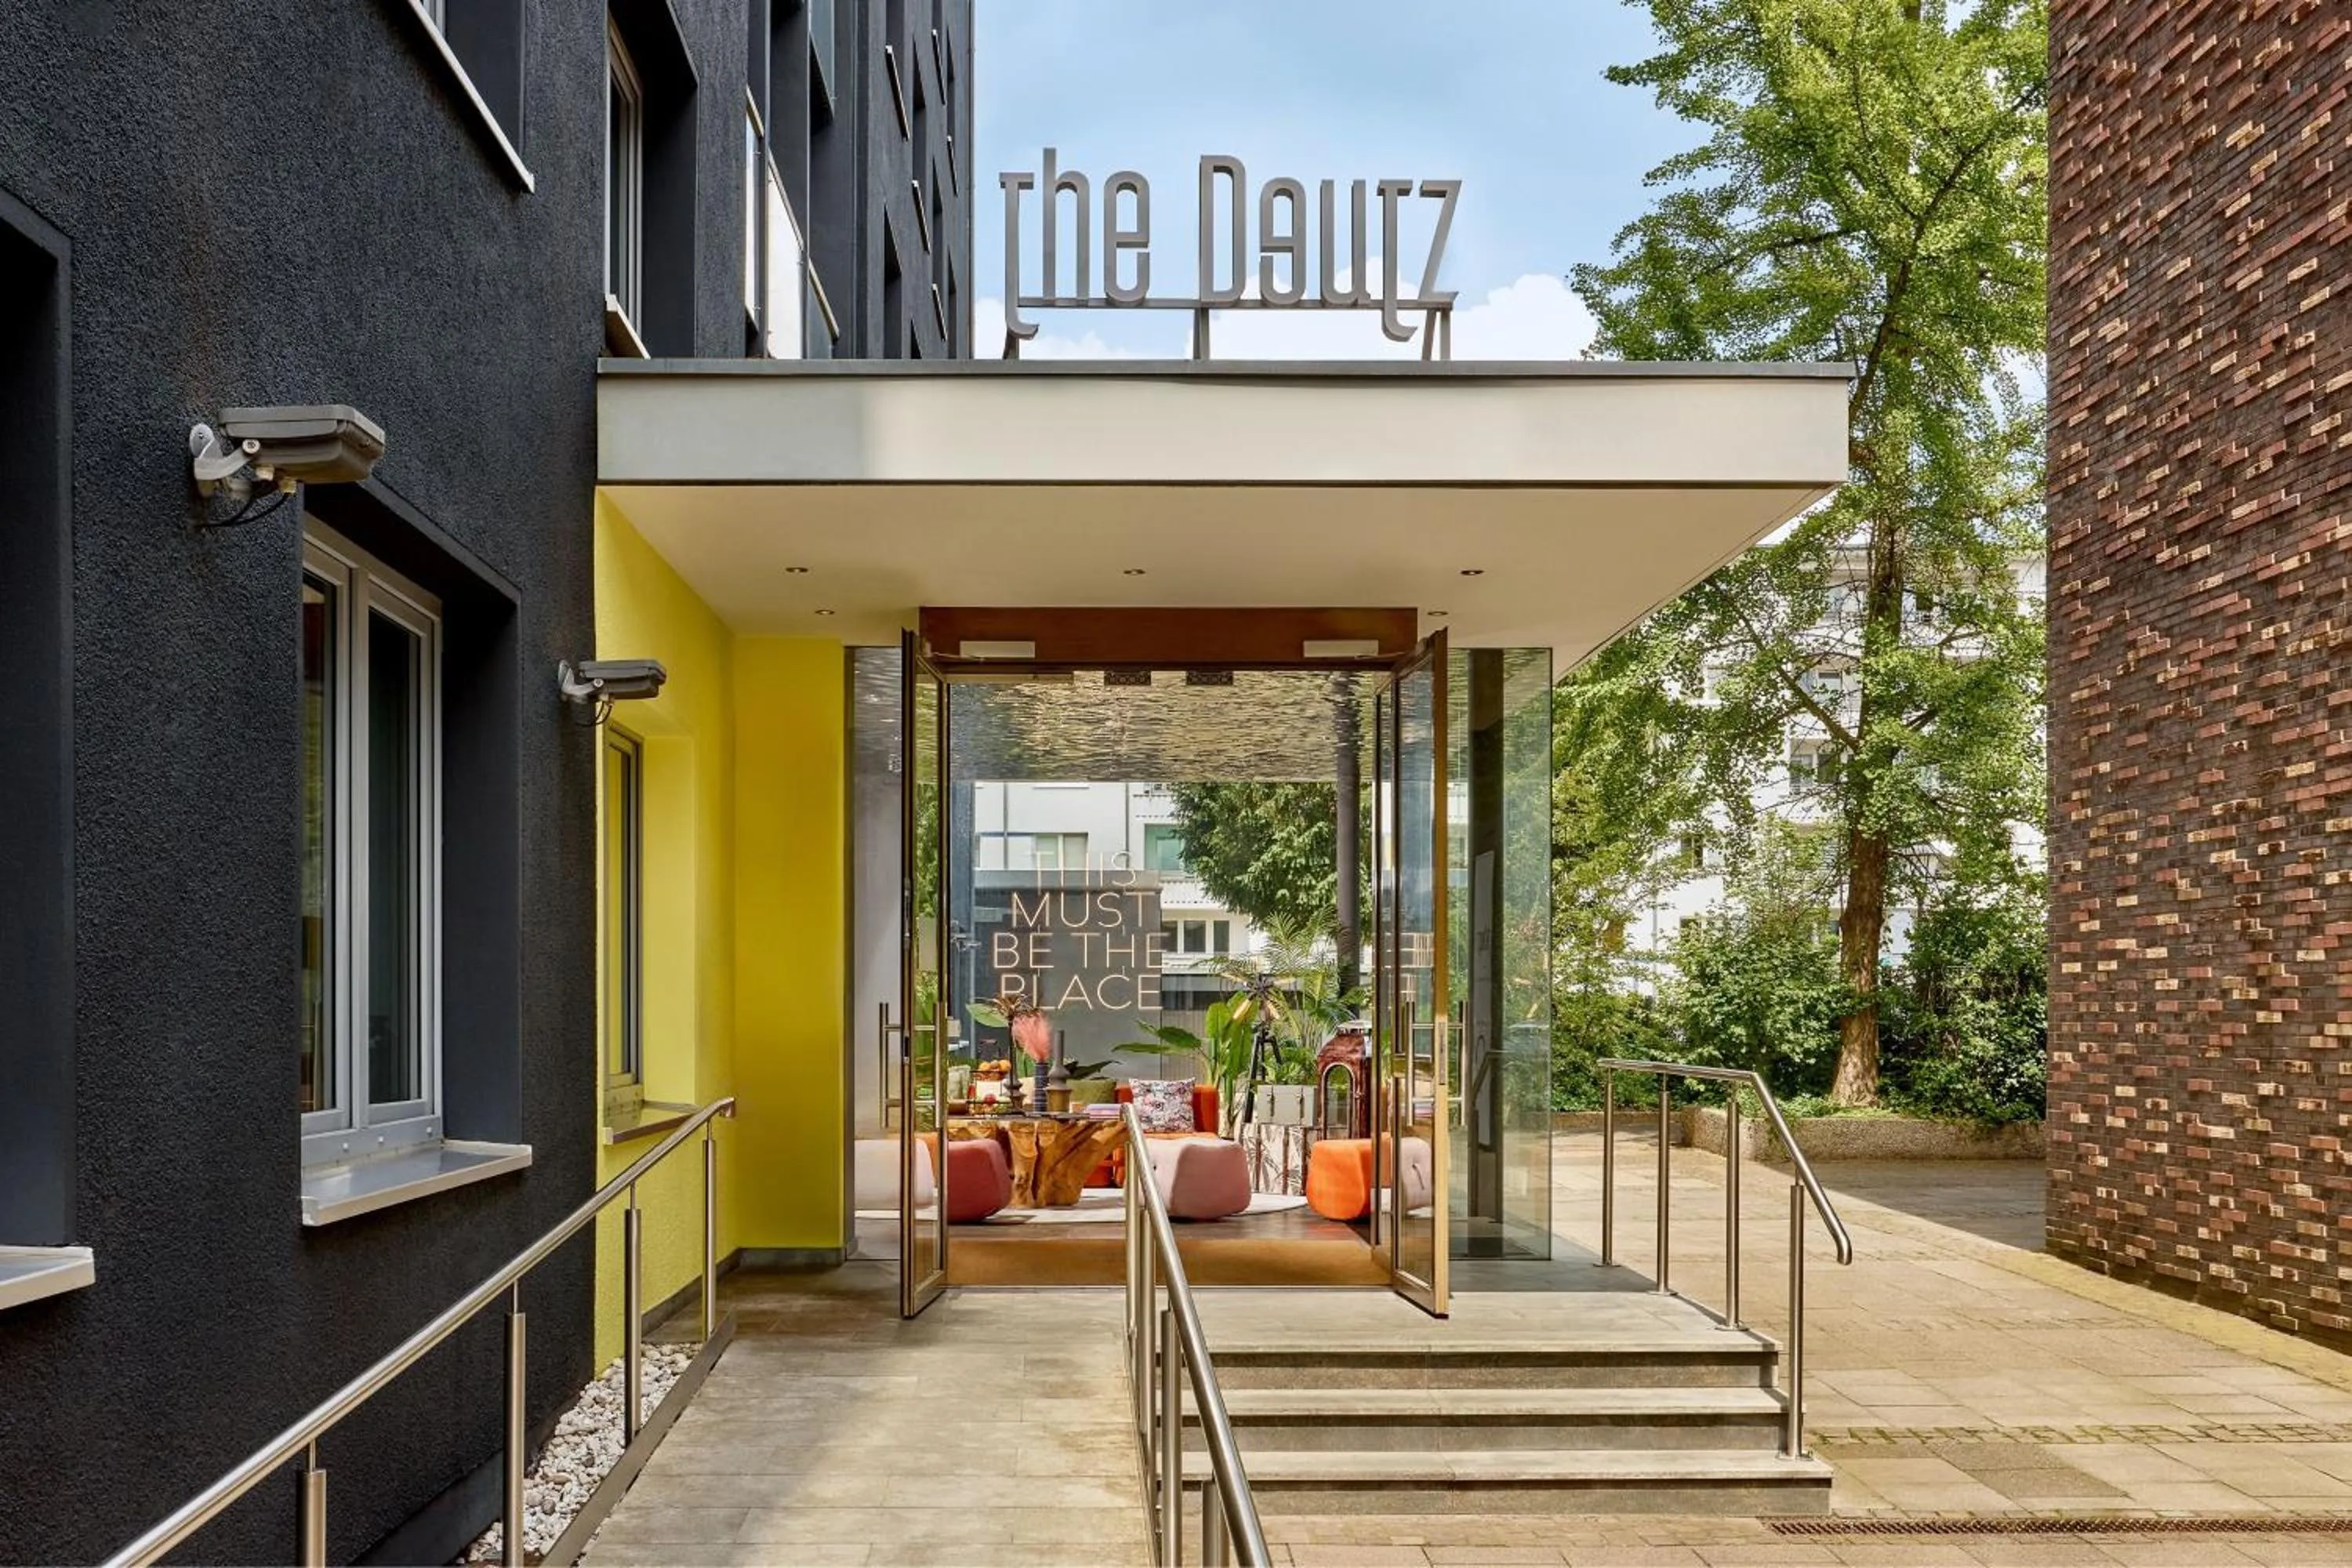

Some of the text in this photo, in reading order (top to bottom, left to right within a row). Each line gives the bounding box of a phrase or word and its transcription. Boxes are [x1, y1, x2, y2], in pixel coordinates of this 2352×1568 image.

[1200, 154, 1462, 342] Deutz
[1034, 851, 1137, 887] THIS
[1011, 891, 1156, 928] MUST
[993, 931, 1171, 969] BE THE
[1000, 974, 1163, 1011] PLACE
